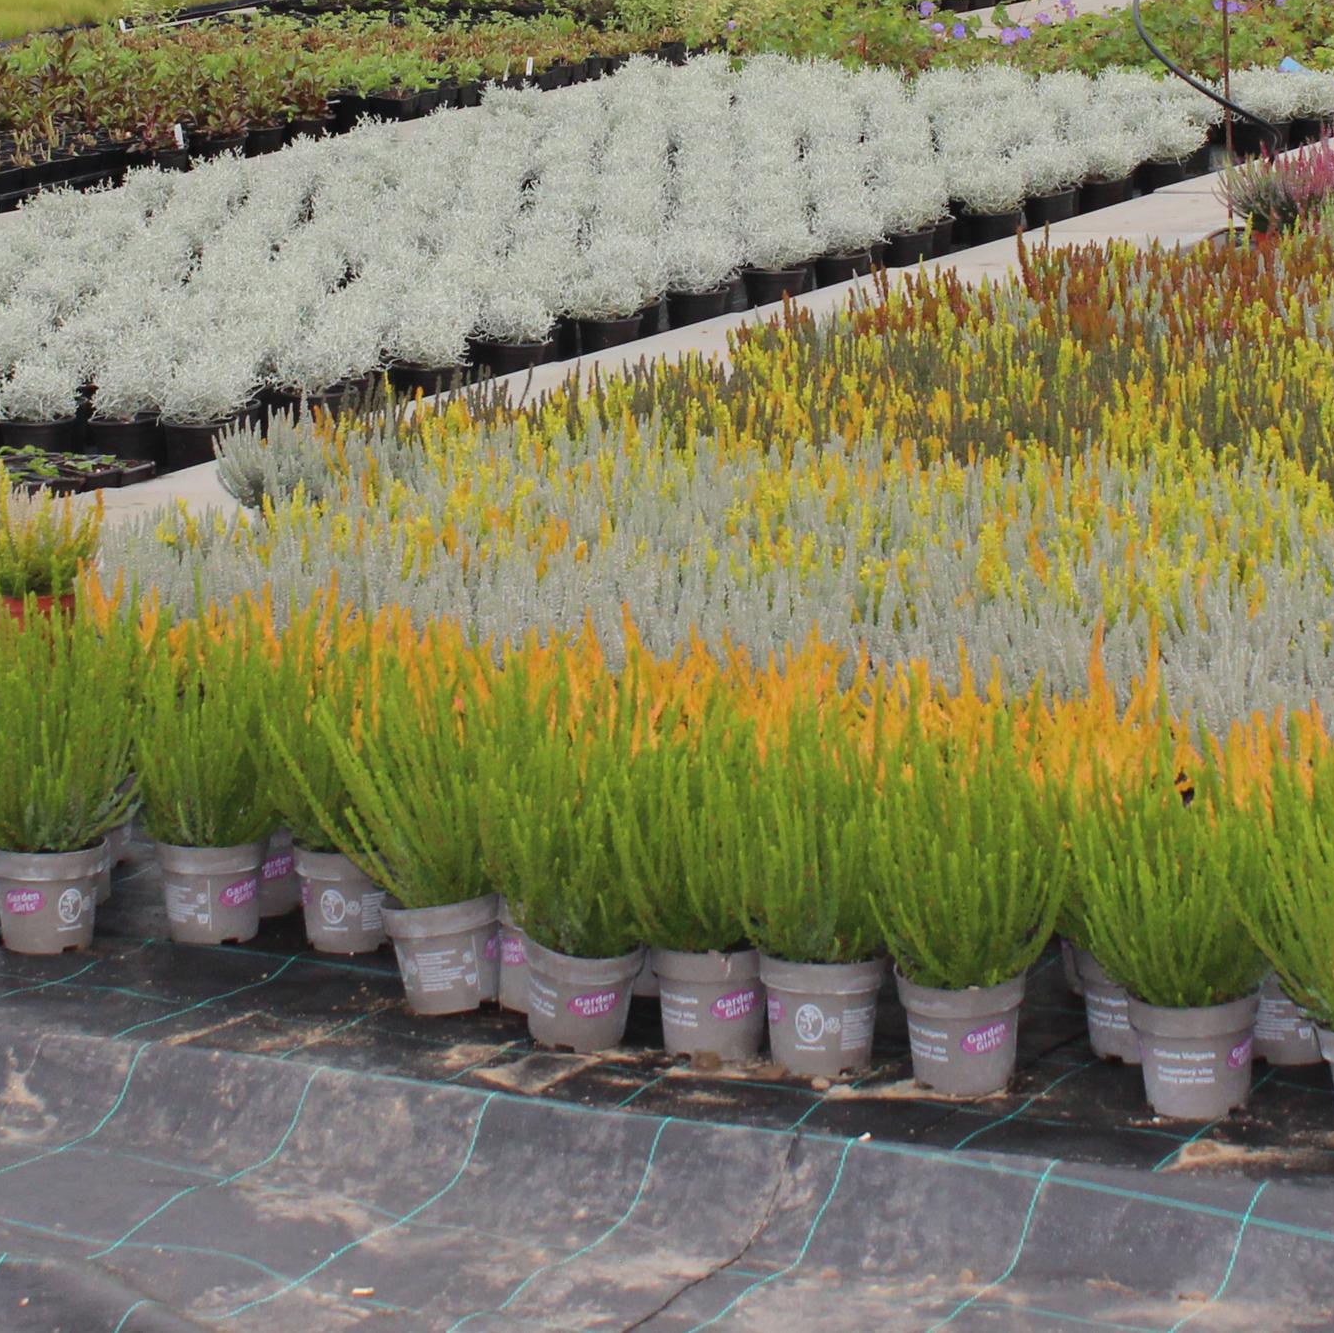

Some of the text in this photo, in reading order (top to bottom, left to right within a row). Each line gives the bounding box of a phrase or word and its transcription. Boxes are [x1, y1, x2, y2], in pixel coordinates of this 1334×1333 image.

[574, 992, 615, 1007] Garden
[717, 991, 754, 1009] Garden
[583, 1003, 609, 1015] Girls
[726, 1003, 750, 1018] Girls
[967, 1023, 1005, 1043] Garden
[976, 1036, 1000, 1051] Girls
